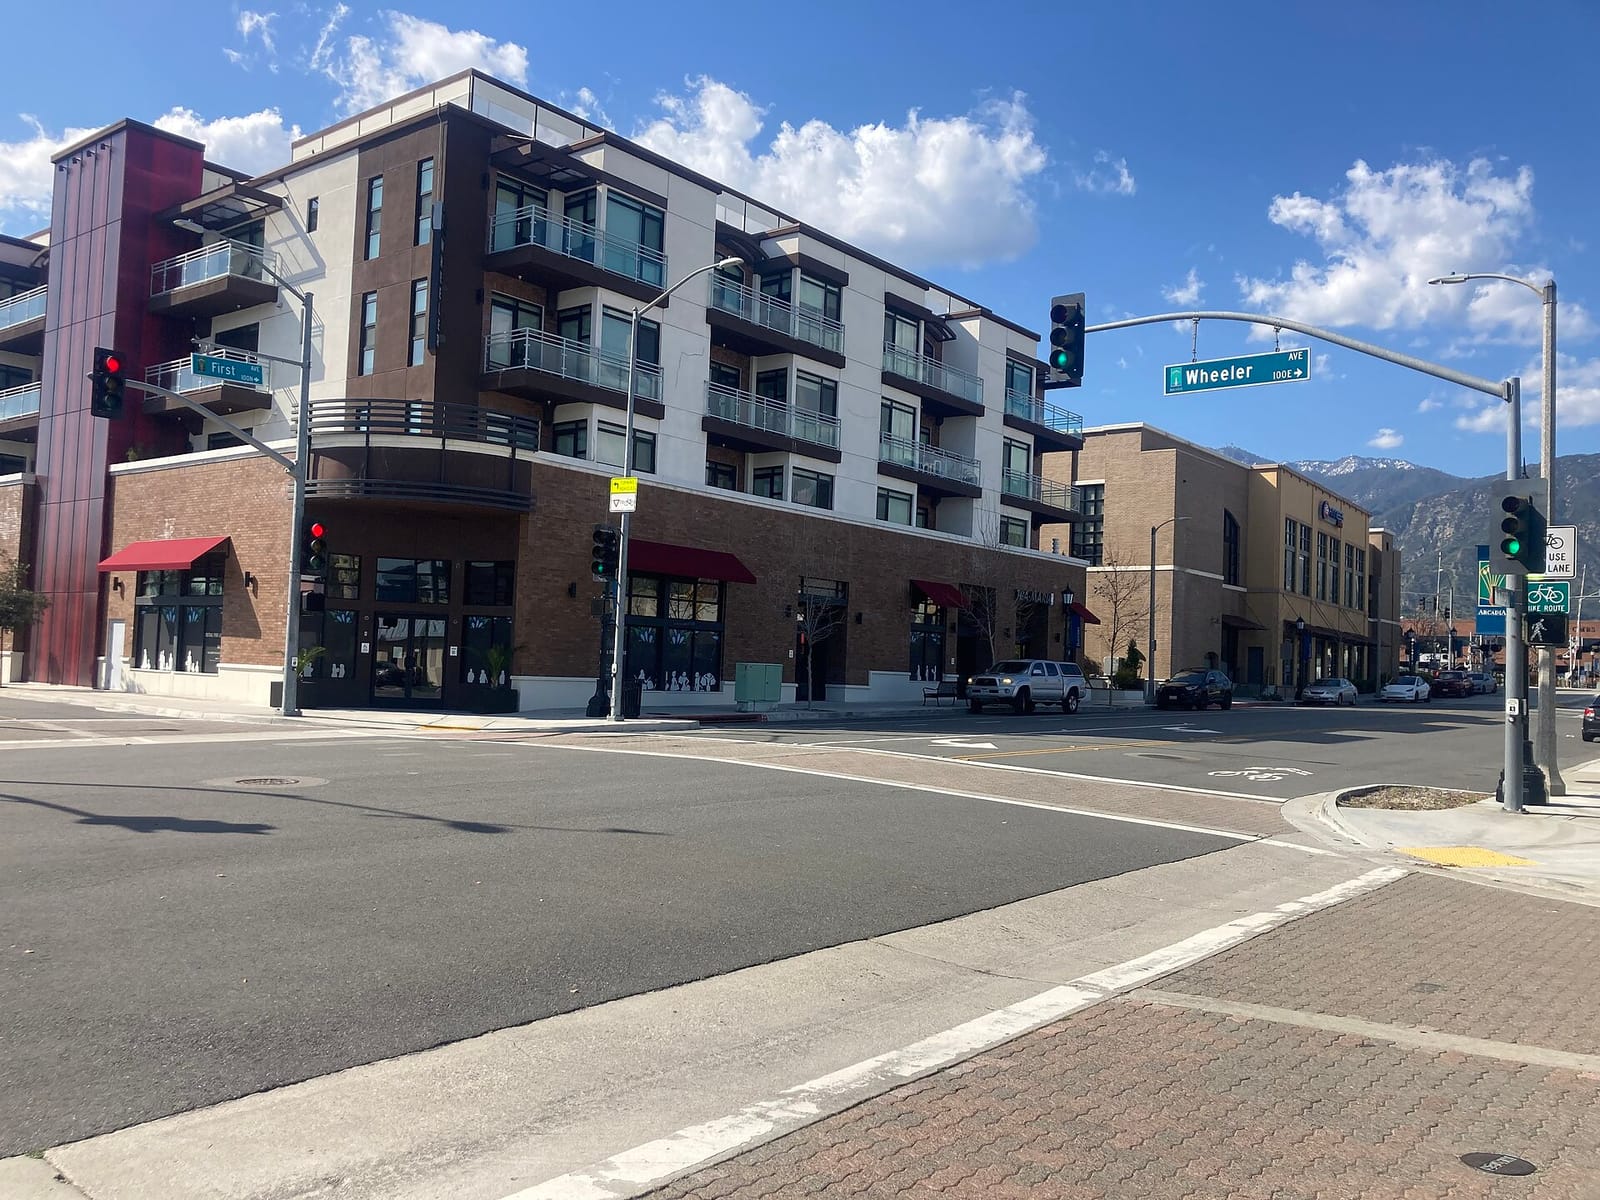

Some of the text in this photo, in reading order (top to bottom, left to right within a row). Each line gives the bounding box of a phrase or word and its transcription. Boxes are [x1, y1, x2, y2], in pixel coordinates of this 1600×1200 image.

[1288, 351, 1303, 361] AVE
[211, 362, 236, 376] First
[1186, 365, 1253, 385] Wheeler
[1273, 370, 1292, 380] 100E
[1549, 553, 1566, 561] USE
[1548, 564, 1570, 573] LANE
